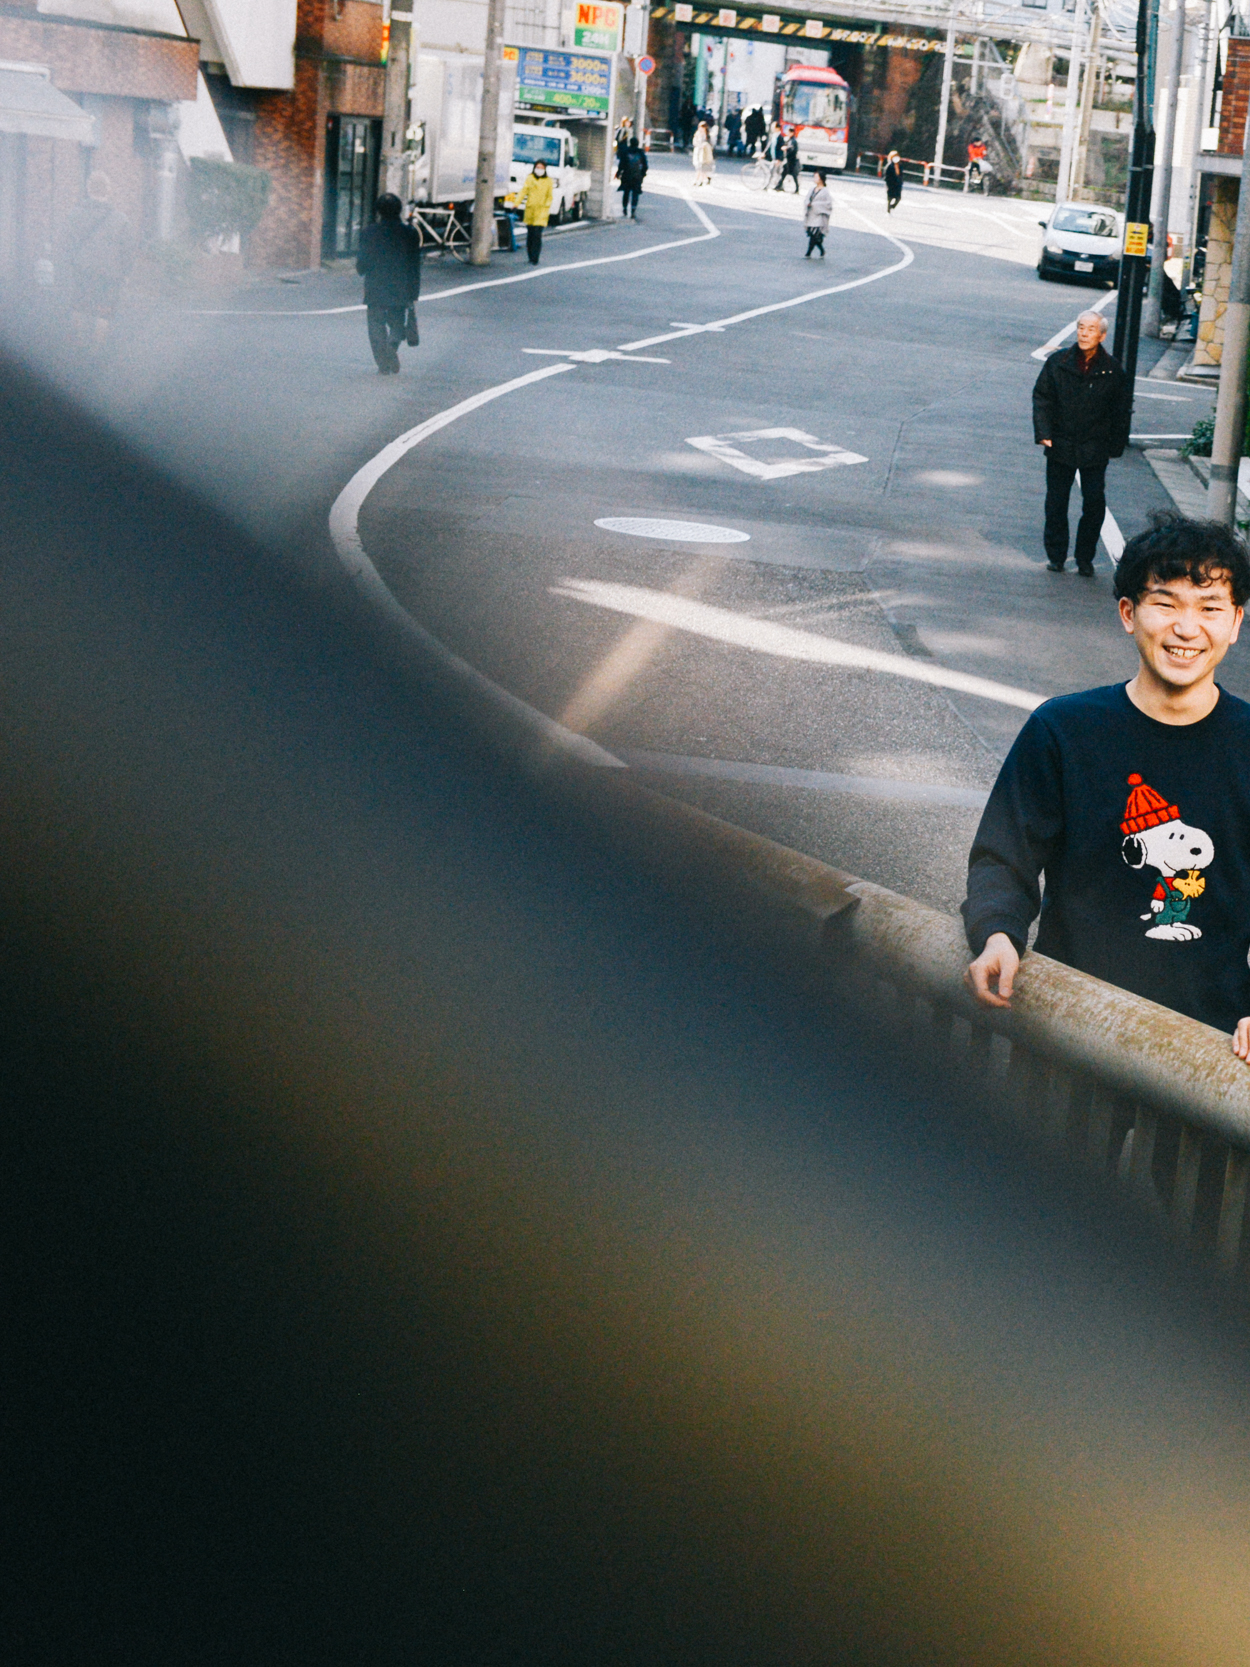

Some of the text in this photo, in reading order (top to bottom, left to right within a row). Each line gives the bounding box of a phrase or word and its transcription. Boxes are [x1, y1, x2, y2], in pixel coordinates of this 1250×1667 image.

[578, 4, 617, 27] NPC
[582, 31, 610, 45] 24H
[503, 49, 516, 61] PC
